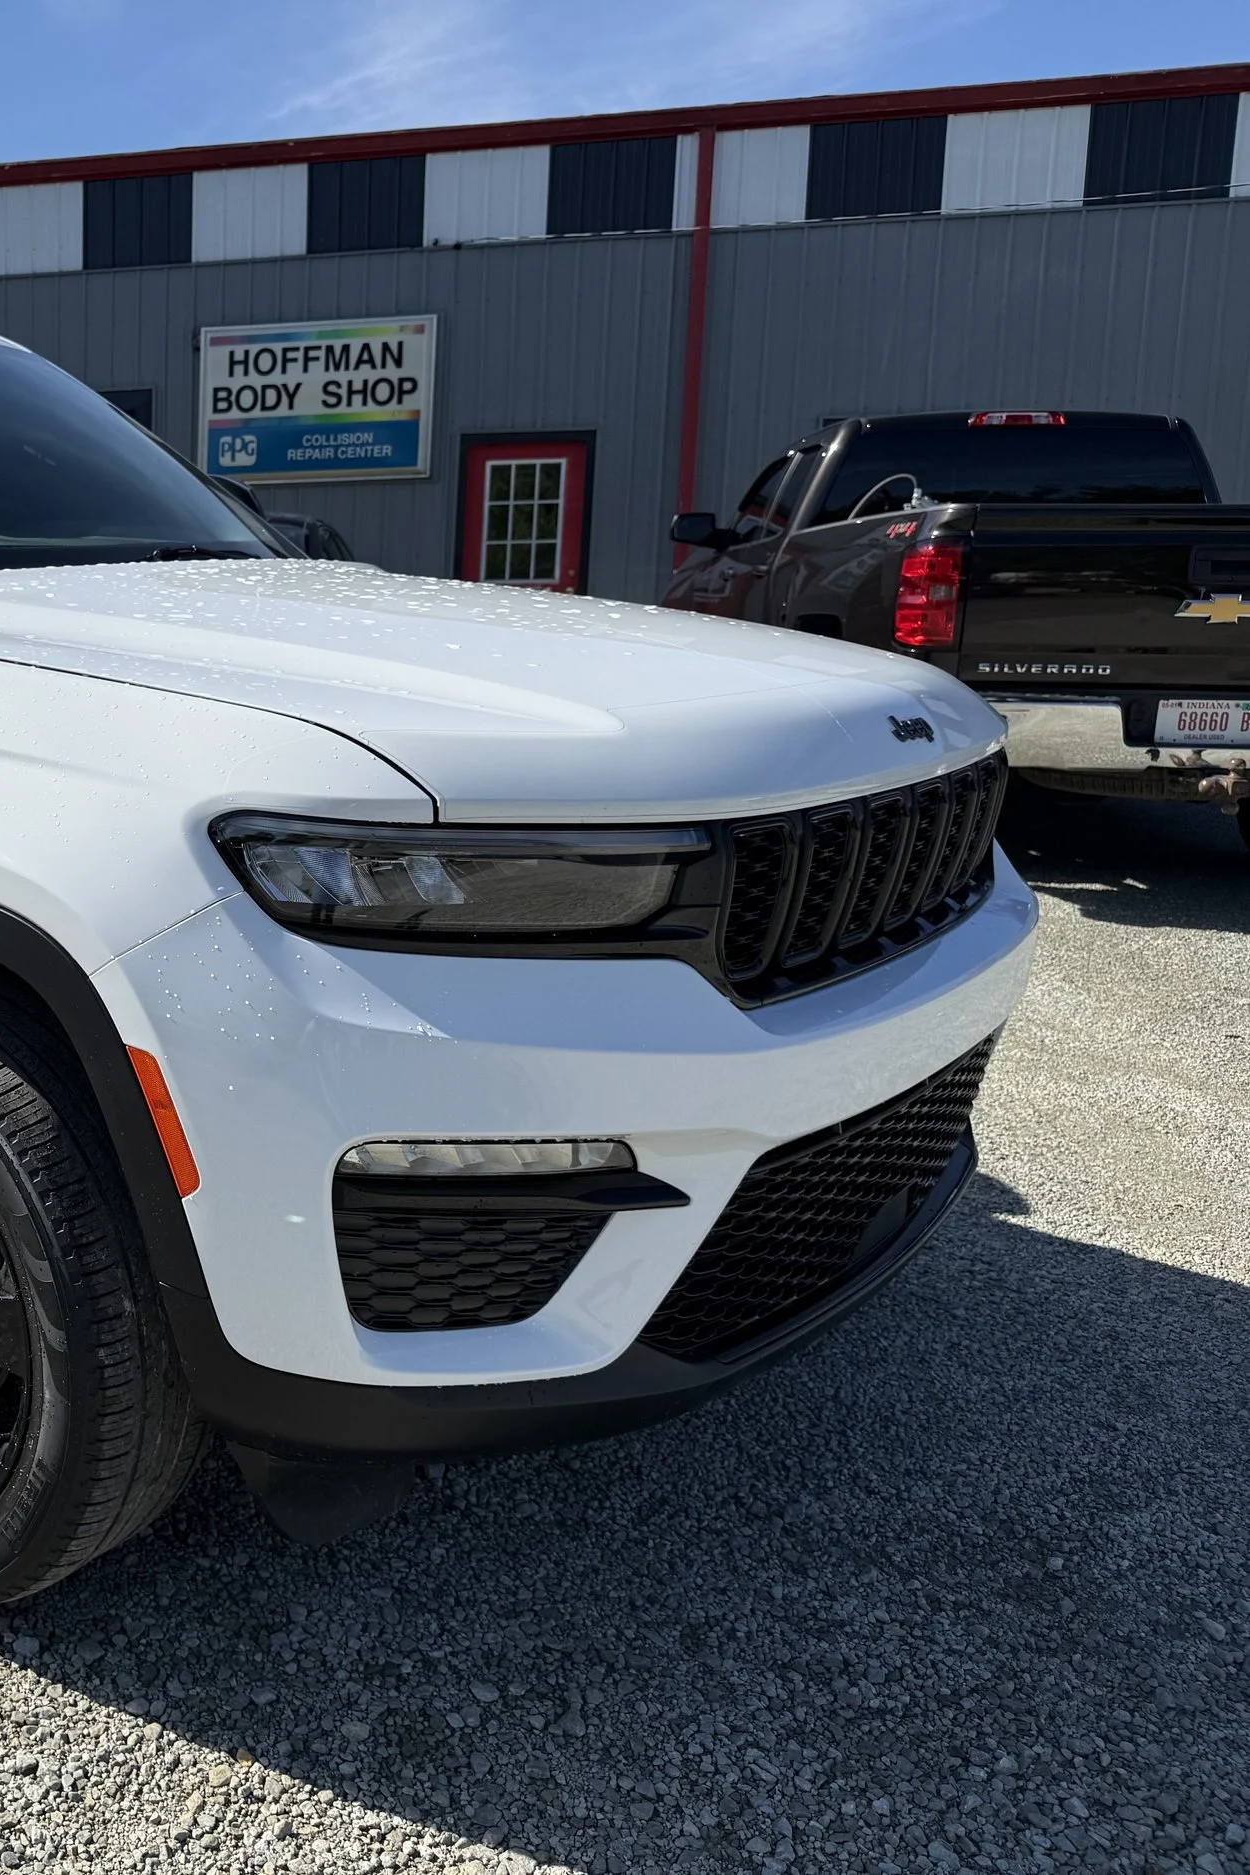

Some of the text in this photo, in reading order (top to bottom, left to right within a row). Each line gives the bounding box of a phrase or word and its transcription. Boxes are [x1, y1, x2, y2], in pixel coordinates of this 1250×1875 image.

[228, 340, 404, 378] HOFFMAN
[212, 377, 418, 414] BODY SHOP
[302, 432, 374, 447] COLLISION
[287, 445, 392, 461] REPAIR CENTER
[977, 662, 1111, 675] SILVERADO
[1186, 701, 1231, 709] INDIANA
[887, 715, 935, 743] Jeep
[1177, 711, 1229, 731] 68660
